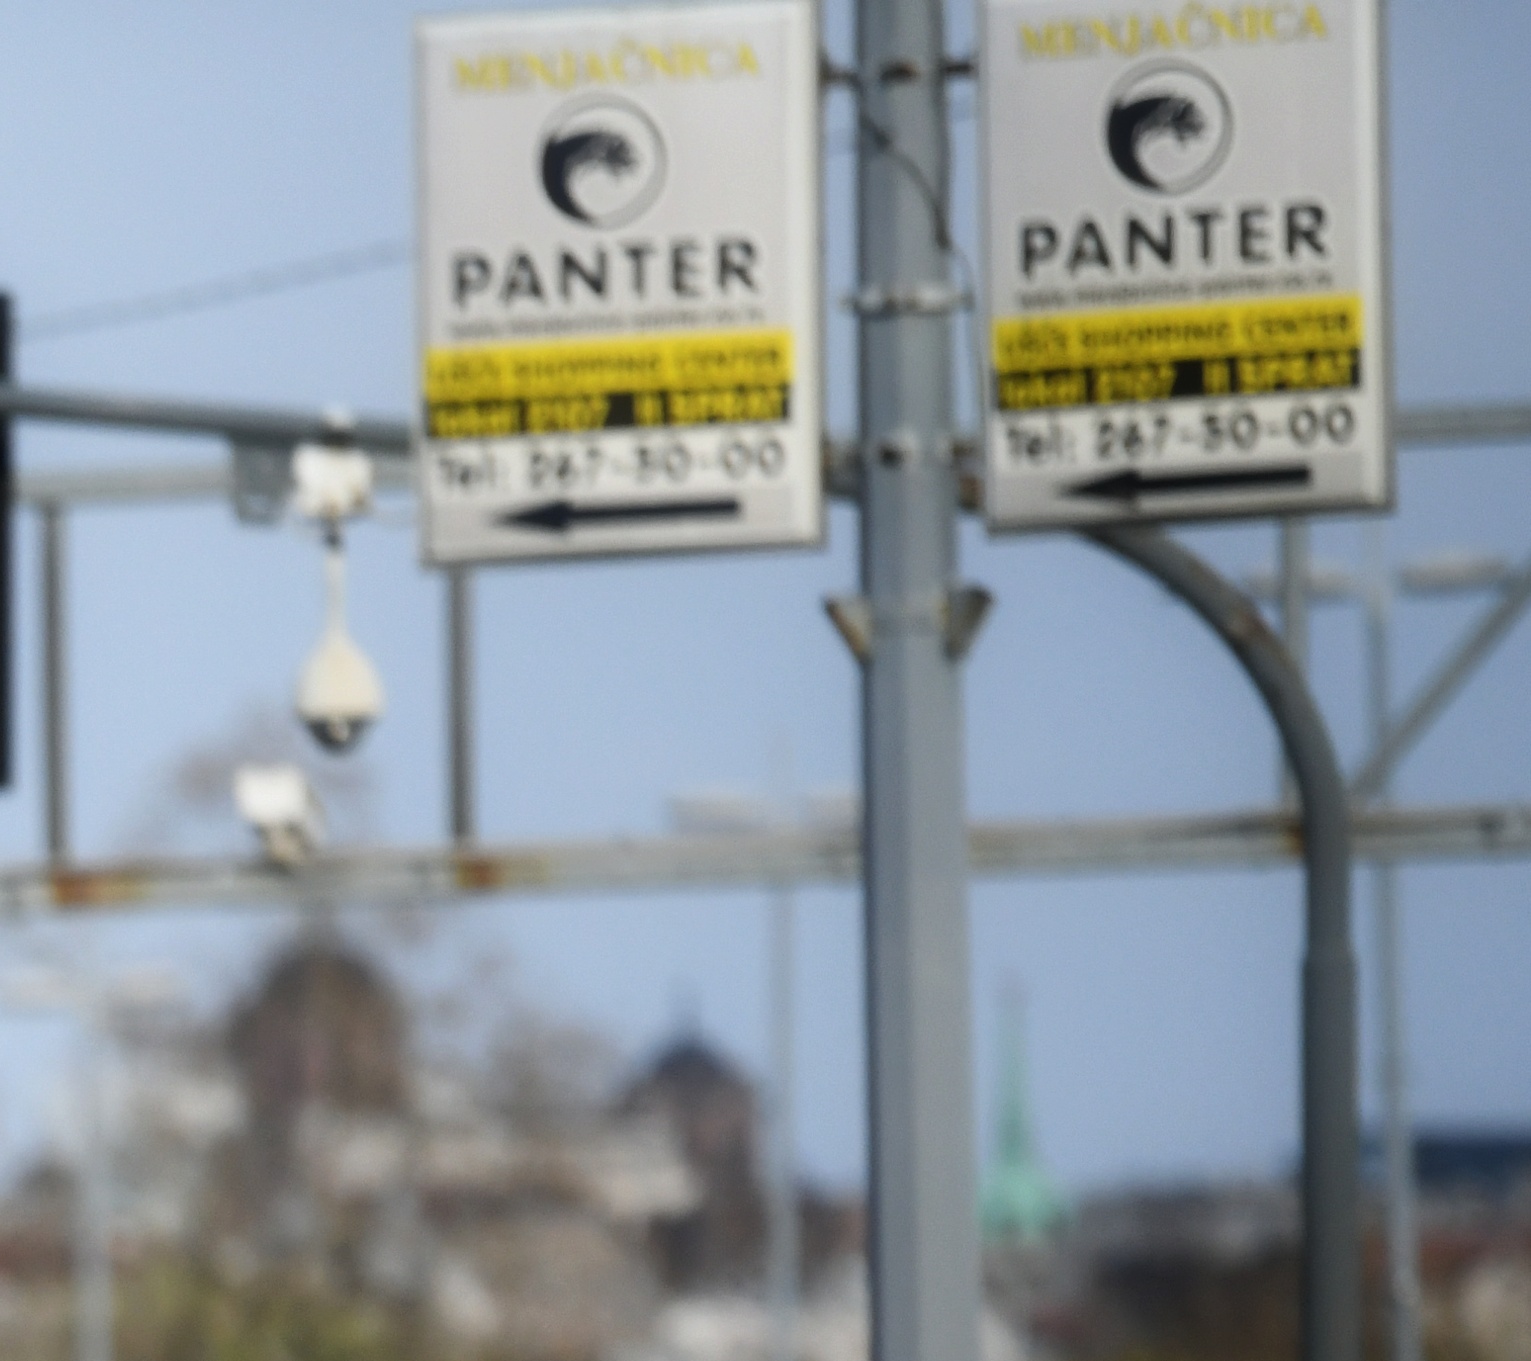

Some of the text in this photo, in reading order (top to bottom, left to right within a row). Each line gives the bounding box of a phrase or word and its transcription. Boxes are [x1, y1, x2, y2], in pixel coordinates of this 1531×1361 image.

[1018, 2, 1327, 60] MENJAČNICA
[452, 38, 760, 93] MENJAČNICA
[1020, 202, 1327, 277] PANTER
[453, 236, 760, 308] PANTER
[1241, 307, 1352, 344] CENTER
